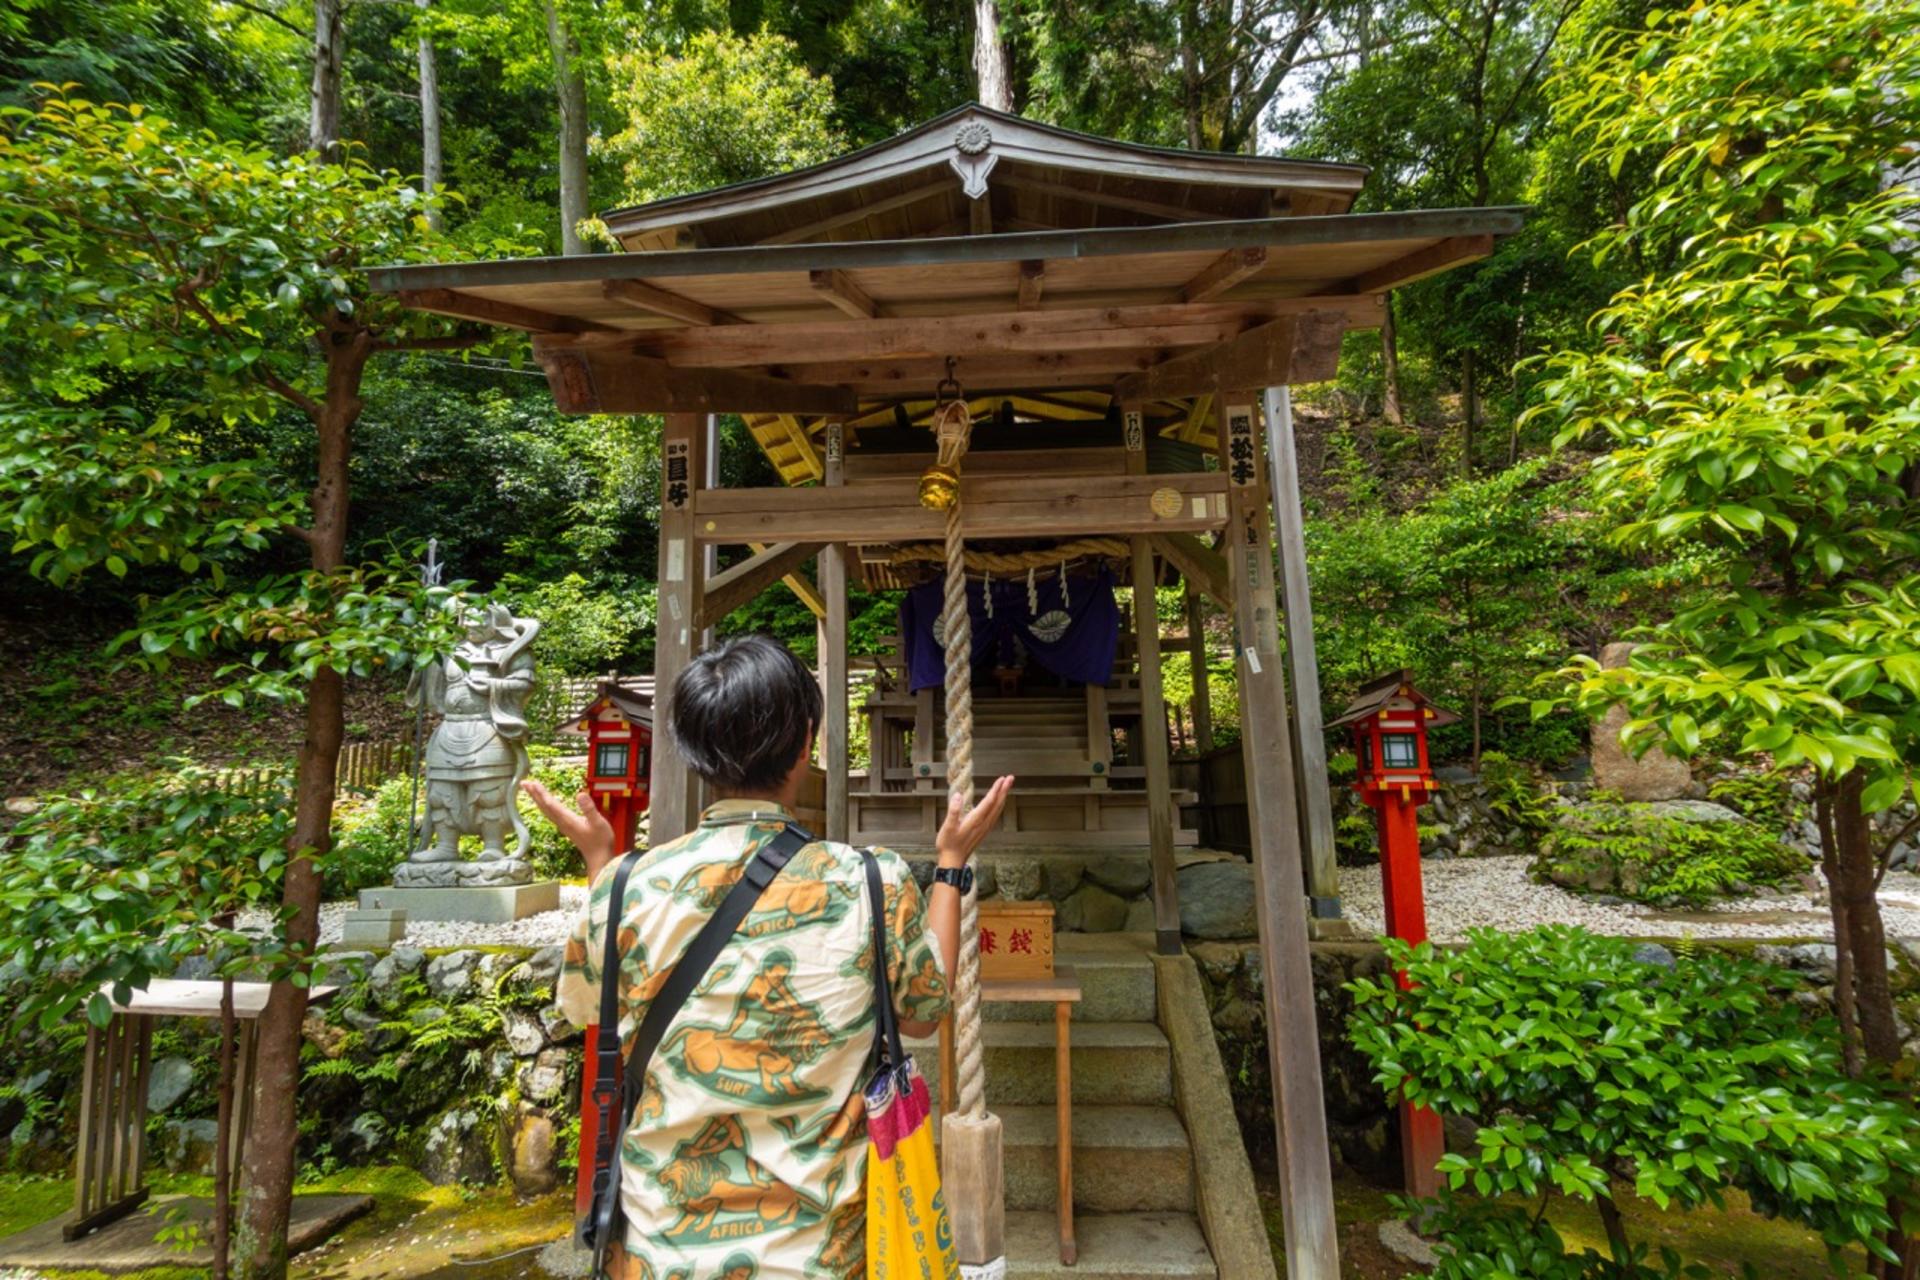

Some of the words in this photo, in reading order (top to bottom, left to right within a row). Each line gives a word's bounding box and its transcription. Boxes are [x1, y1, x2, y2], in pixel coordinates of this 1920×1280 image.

[749, 916, 796, 937] AFRICA
[715, 1076, 752, 1096] SURF
[708, 1221, 764, 1239] AFRICA
